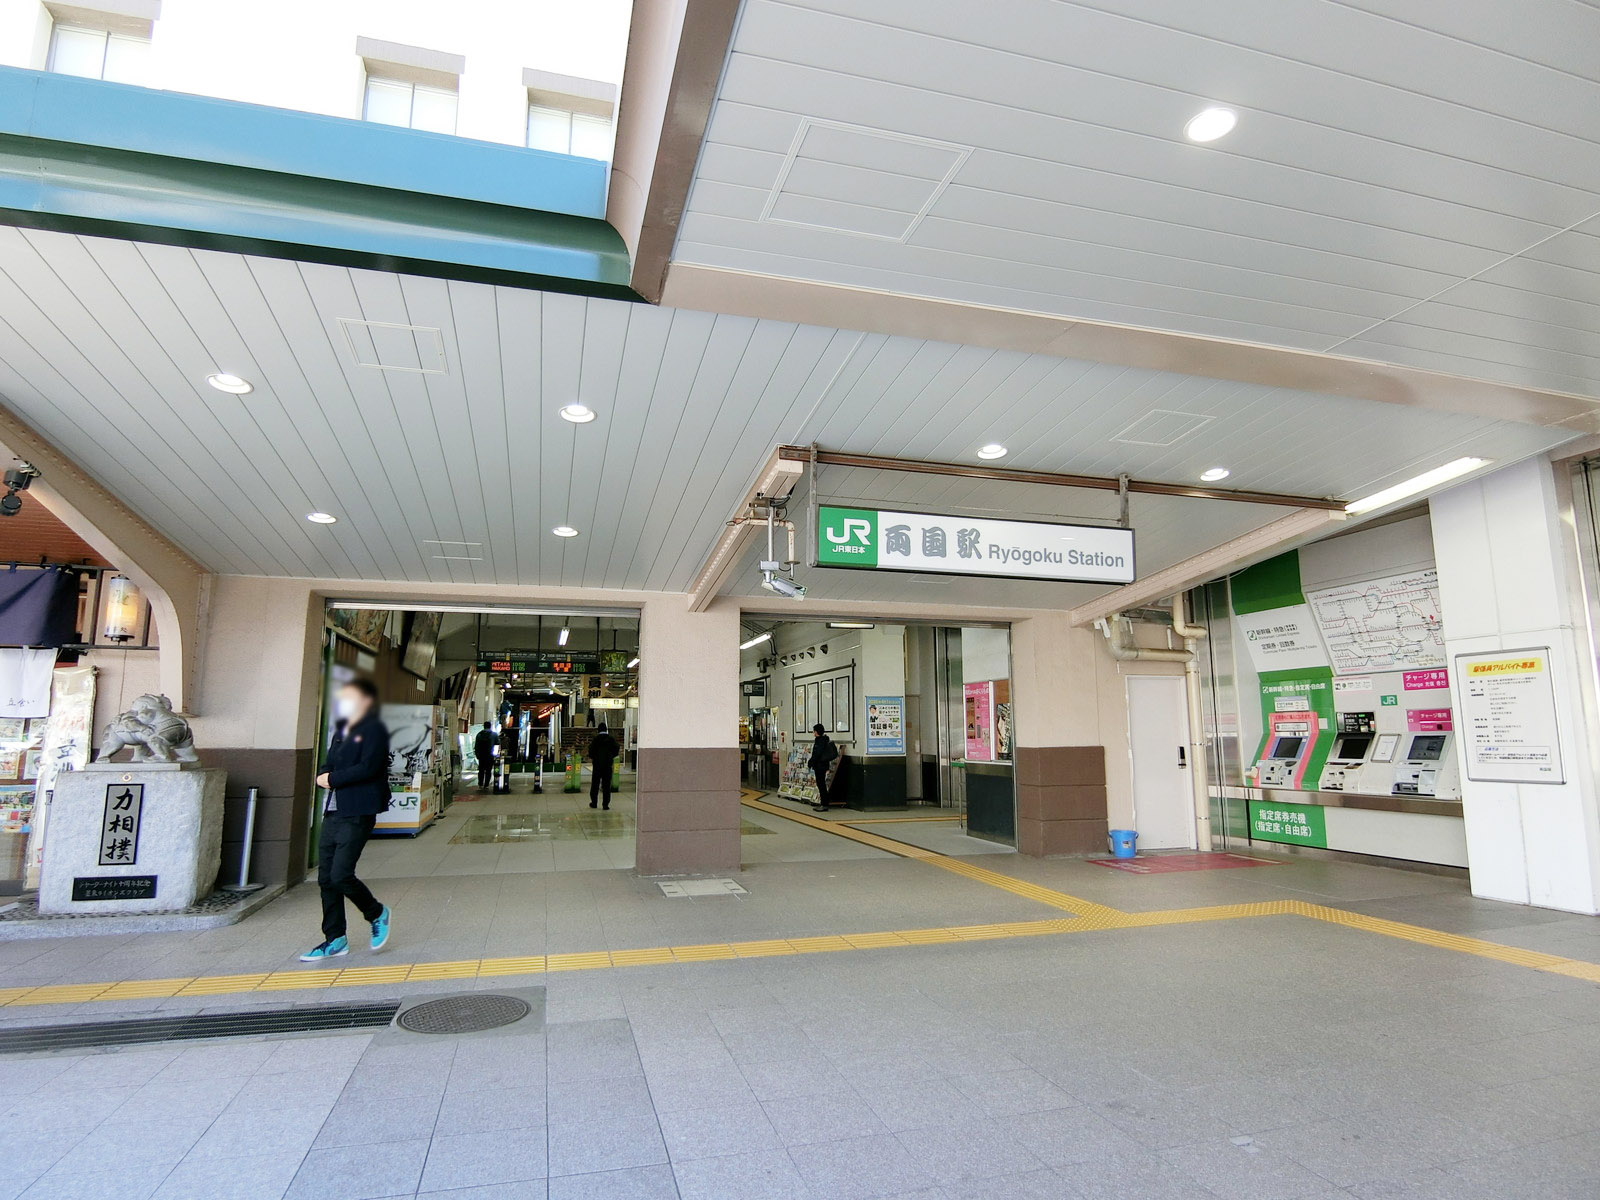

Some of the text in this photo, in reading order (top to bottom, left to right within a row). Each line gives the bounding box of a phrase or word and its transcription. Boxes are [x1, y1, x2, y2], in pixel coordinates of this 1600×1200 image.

[826, 518, 871, 545] JR
[988, 543, 1063, 566] Ryōgoku
[1068, 549, 1124, 568] Station
[541, 653, 546, 661] 2
[1405, 671, 1446, 682] チャージ専用
[1382, 696, 1396, 705] JR
[398, 796, 418, 807] JR
[1258, 809, 1306, 824] 指定席券売機
[105, 787, 134, 861] 力相撲
